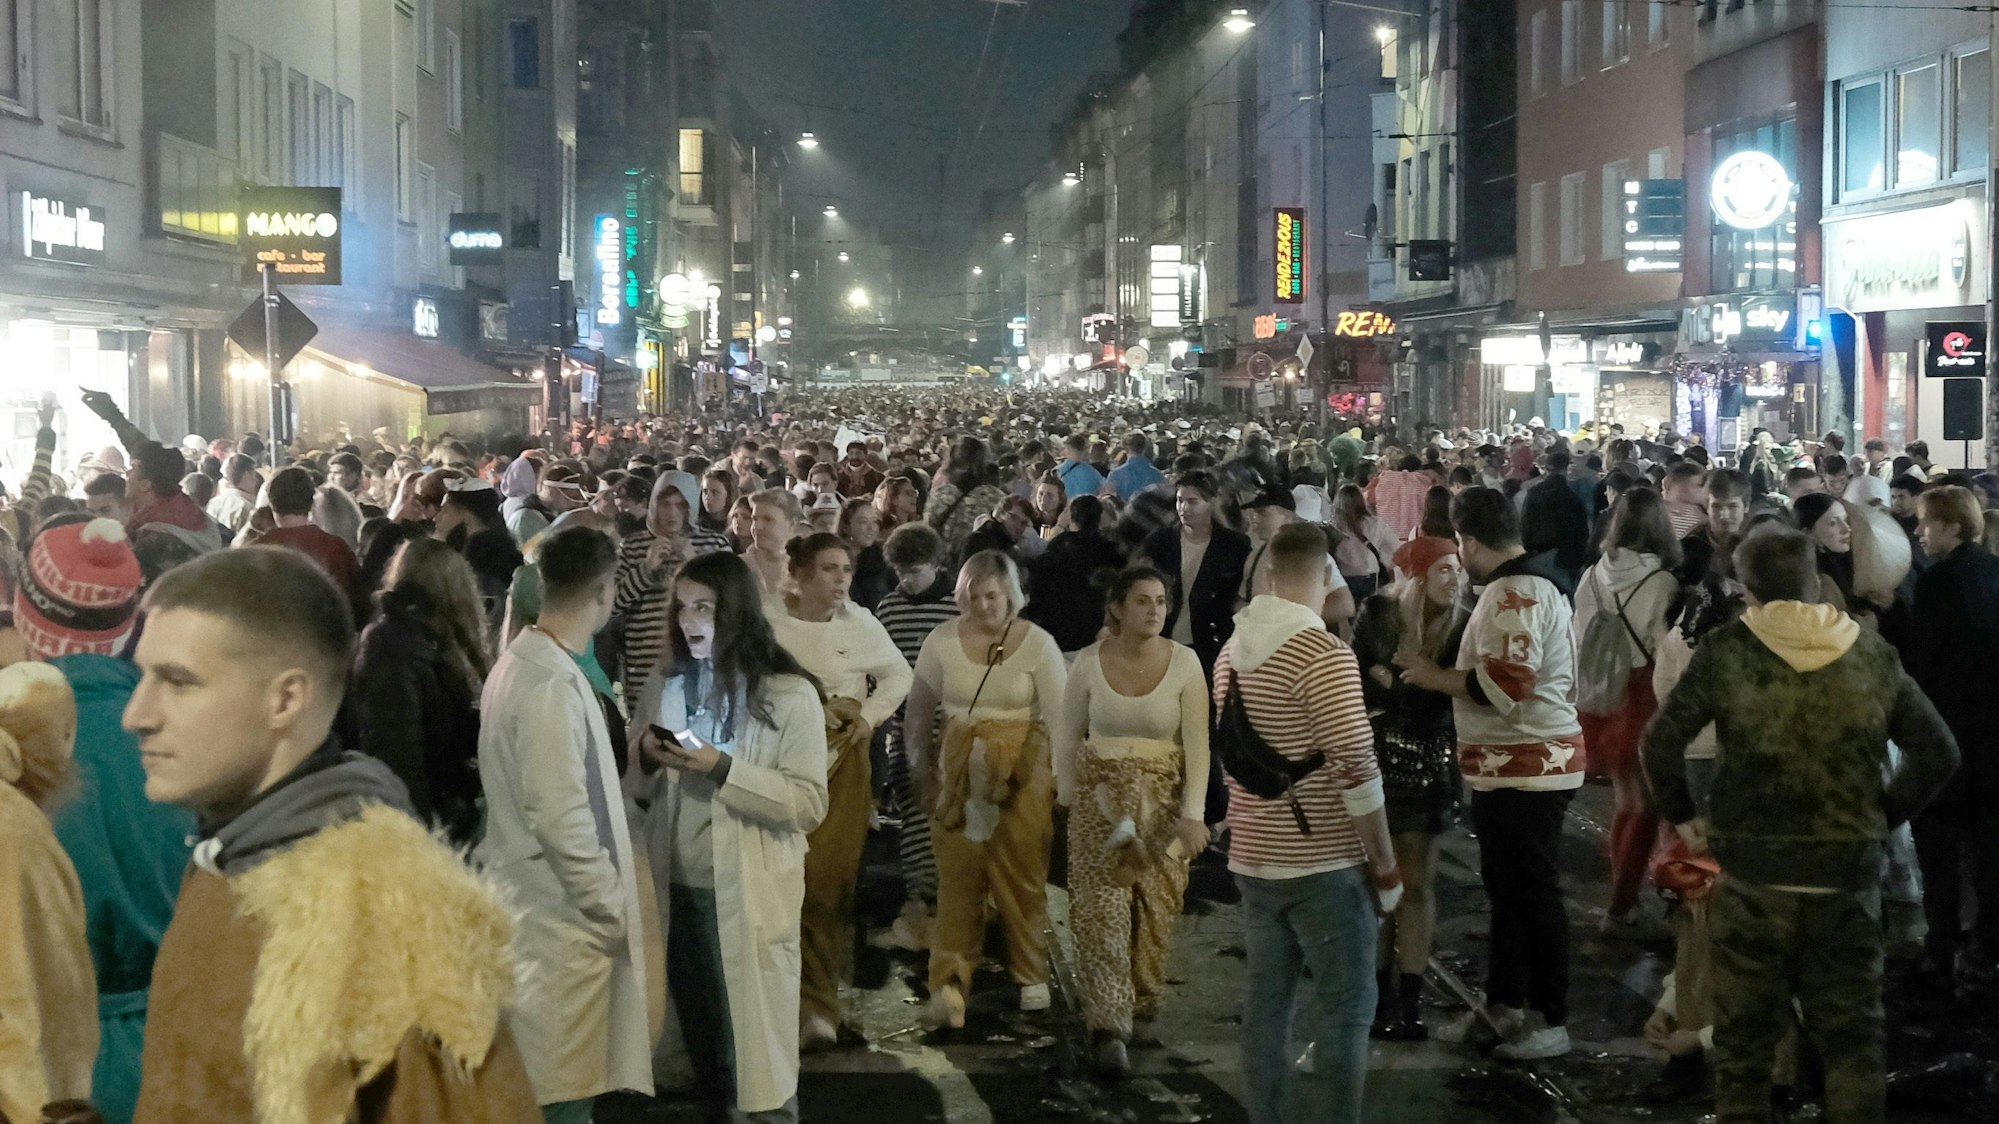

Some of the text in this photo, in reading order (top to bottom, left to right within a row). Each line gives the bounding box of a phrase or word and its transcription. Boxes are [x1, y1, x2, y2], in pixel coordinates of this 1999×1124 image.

[246, 212, 338, 237] MANGO
[256, 262, 326, 274] rtaurant
[301, 249, 326, 261] bar
[1276, 212, 1292, 299] RENDEZVOUS
[597, 217, 620, 324] Borsalino
[1746, 305, 1790, 332] sky
[1502, 632, 1530, 662] 13
